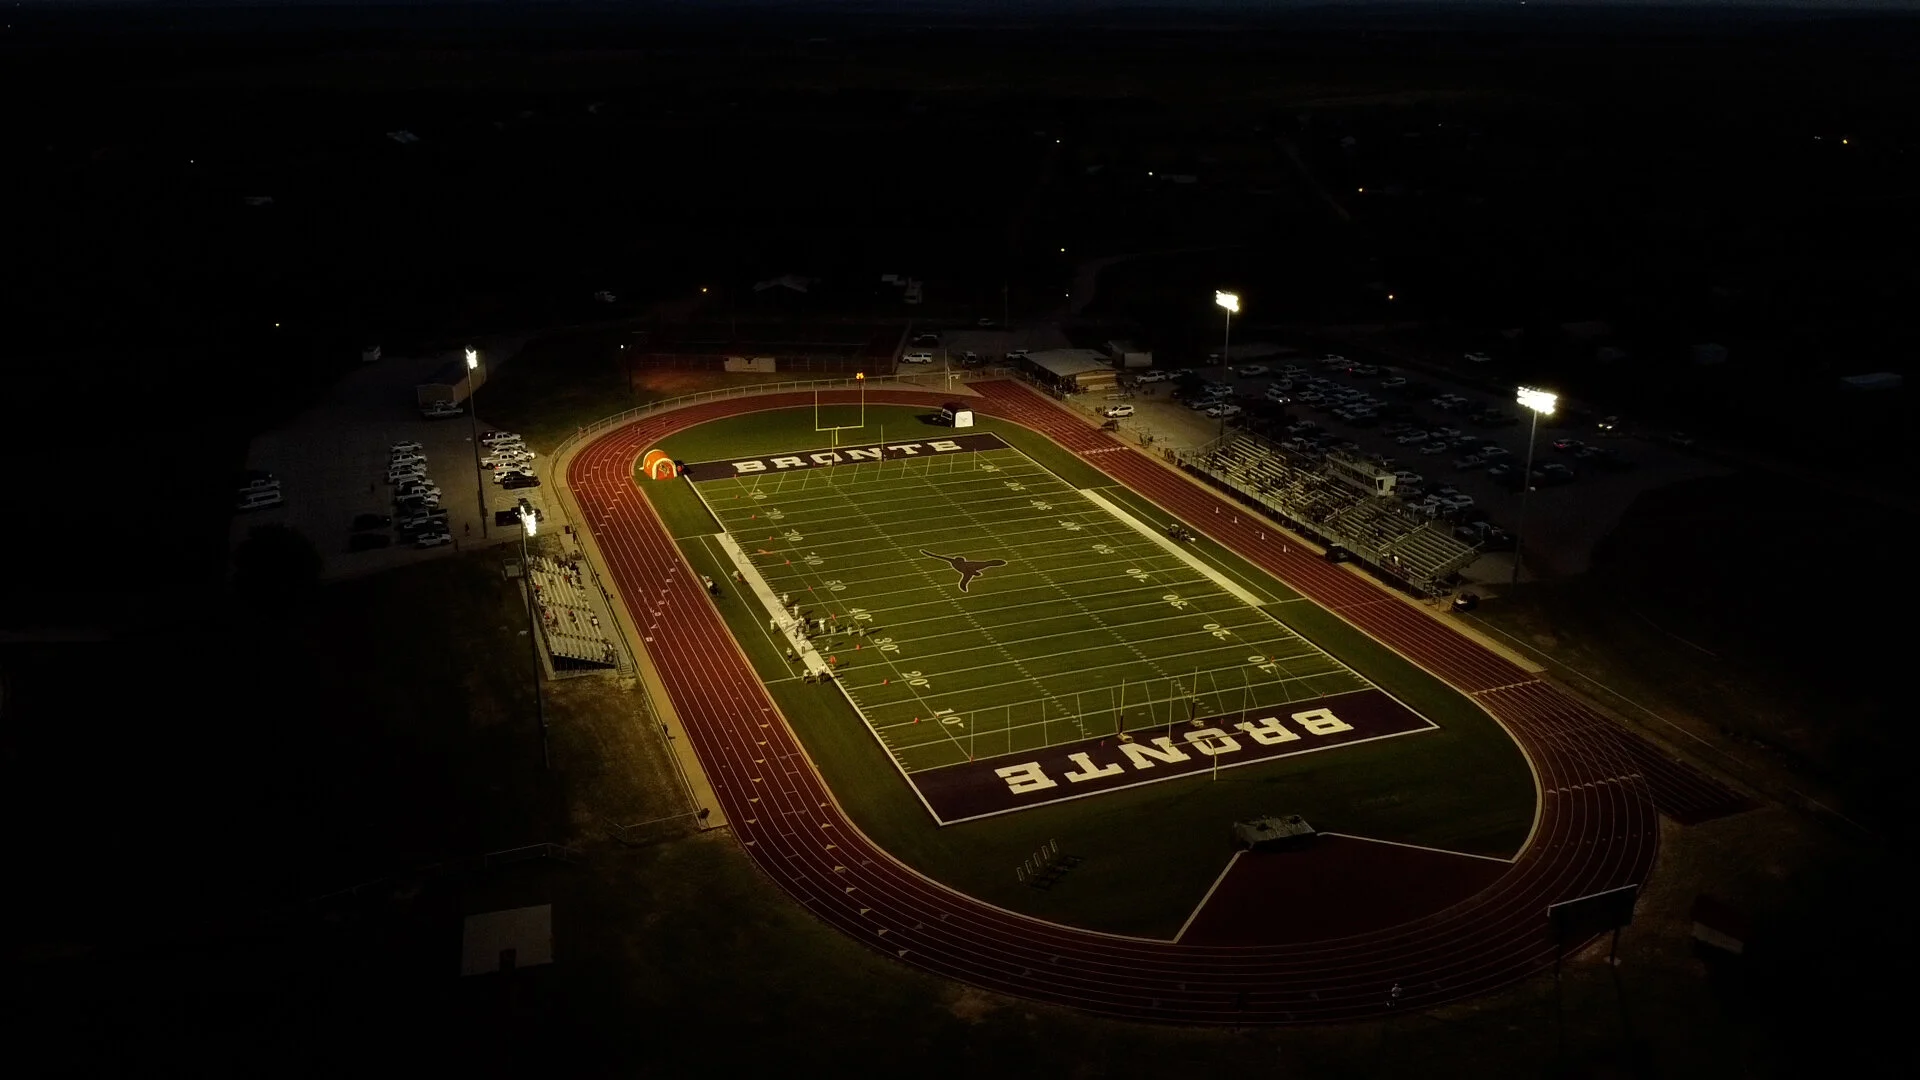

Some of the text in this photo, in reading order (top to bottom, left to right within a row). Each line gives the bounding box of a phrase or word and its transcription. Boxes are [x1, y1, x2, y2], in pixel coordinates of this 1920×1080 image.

[731, 440, 962, 473] BRONTE
[1162, 594, 1188, 607] 30
[849, 608, 872, 620] 40
[1203, 624, 1231, 637] 20
[874, 638, 898, 651] 30
[1248, 656, 1277, 669] 10
[901, 670, 928, 686] 20
[934, 708, 962, 724] 10
[994, 707, 1355, 794] BRONTE
